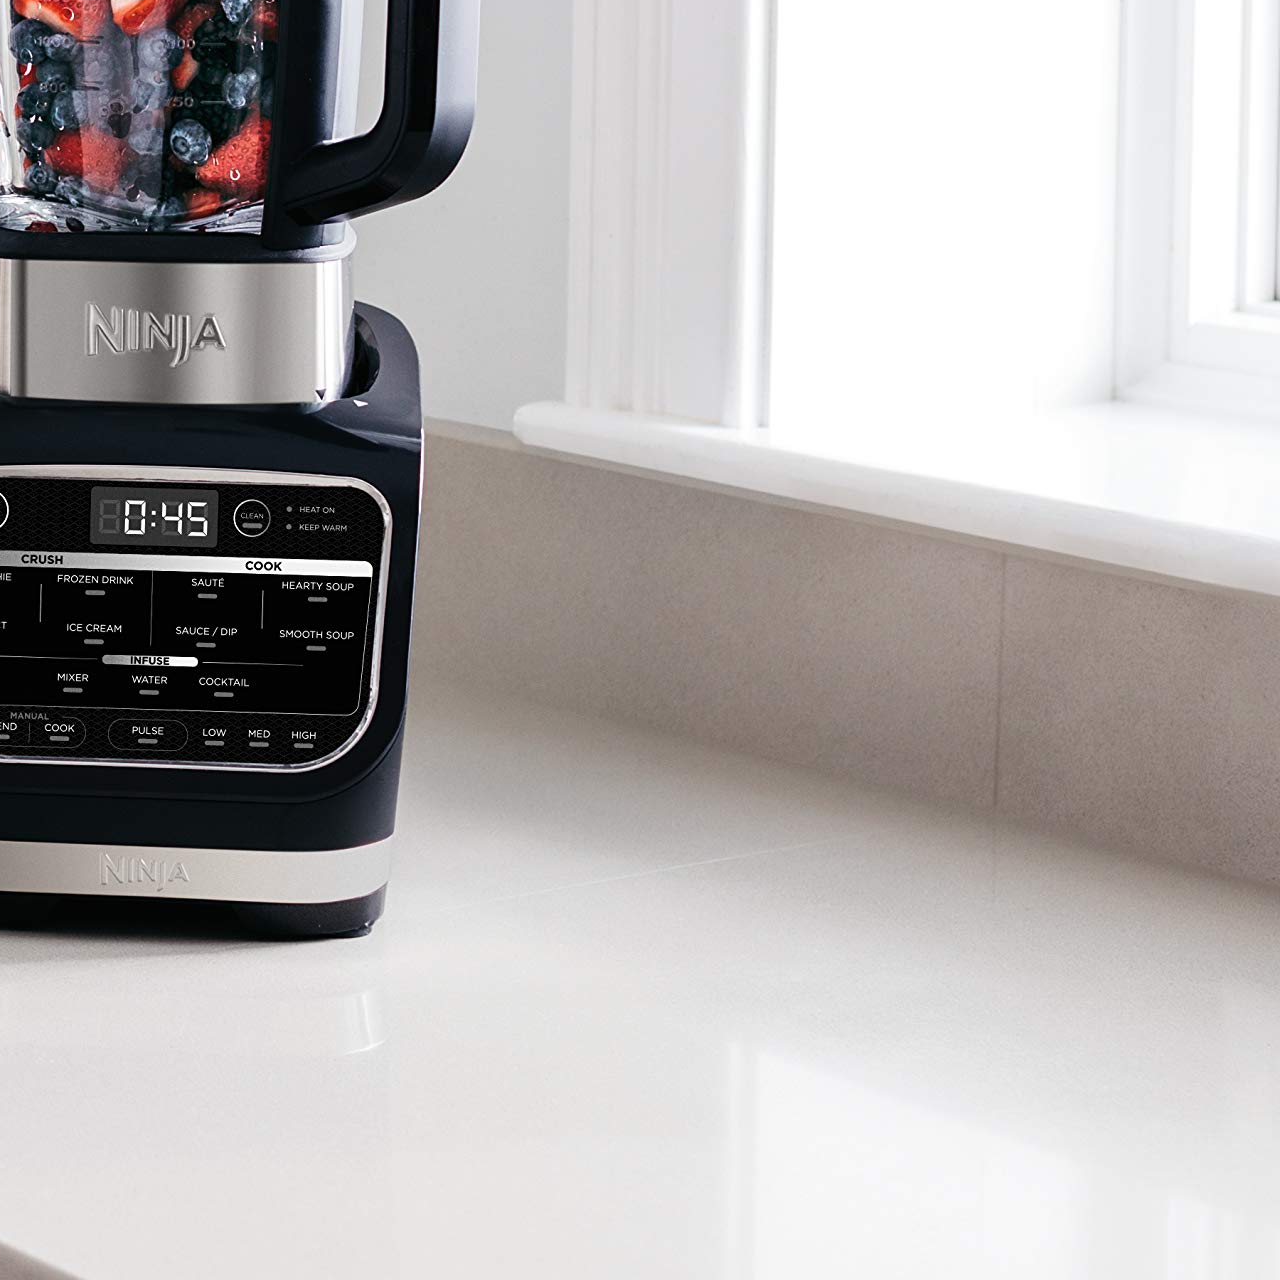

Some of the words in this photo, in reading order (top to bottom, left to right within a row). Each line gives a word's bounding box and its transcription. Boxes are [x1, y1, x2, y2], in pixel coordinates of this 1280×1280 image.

[39, 81, 68, 94] 800
[85, 301, 227, 368] NINJA
[299, 506, 321, 514] HEAT
[322, 506, 335, 514] ON
[124, 499, 209, 537] 0:45
[299, 523, 320, 531] KEEP
[322, 524, 348, 532] WARM
[20, 553, 64, 565] CRUSH
[244, 560, 283, 572] COOK
[57, 574, 99, 584] FROZEN
[101, 575, 134, 585] DRINK
[191, 577, 225, 588] SAUTÉ
[281, 581, 323, 591] HEARTY
[325, 582, 355, 592] SOUP
[66, 623, 84, 632] ICE
[85, 623, 122, 633] CREAM
[175, 626, 209, 636] SAUCE
[220, 627, 238, 636] DIP
[279, 629, 323, 639] SMOOTH
[324, 630, 355, 640] SOUP
[130, 656, 170, 666] INFUSE
[57, 672, 89, 682] MIXER
[131, 675, 168, 685] WATER
[198, 677, 250, 687] COCKTAIL
[10, 711, 50, 720] MANUAL
[44, 723, 75, 733] COOK
[131, 725, 164, 736] PULSE
[202, 728, 227, 737] LOW
[248, 729, 271, 739] MED
[291, 730, 317, 740] HIGH
[100, 851, 190, 892] NINJA
